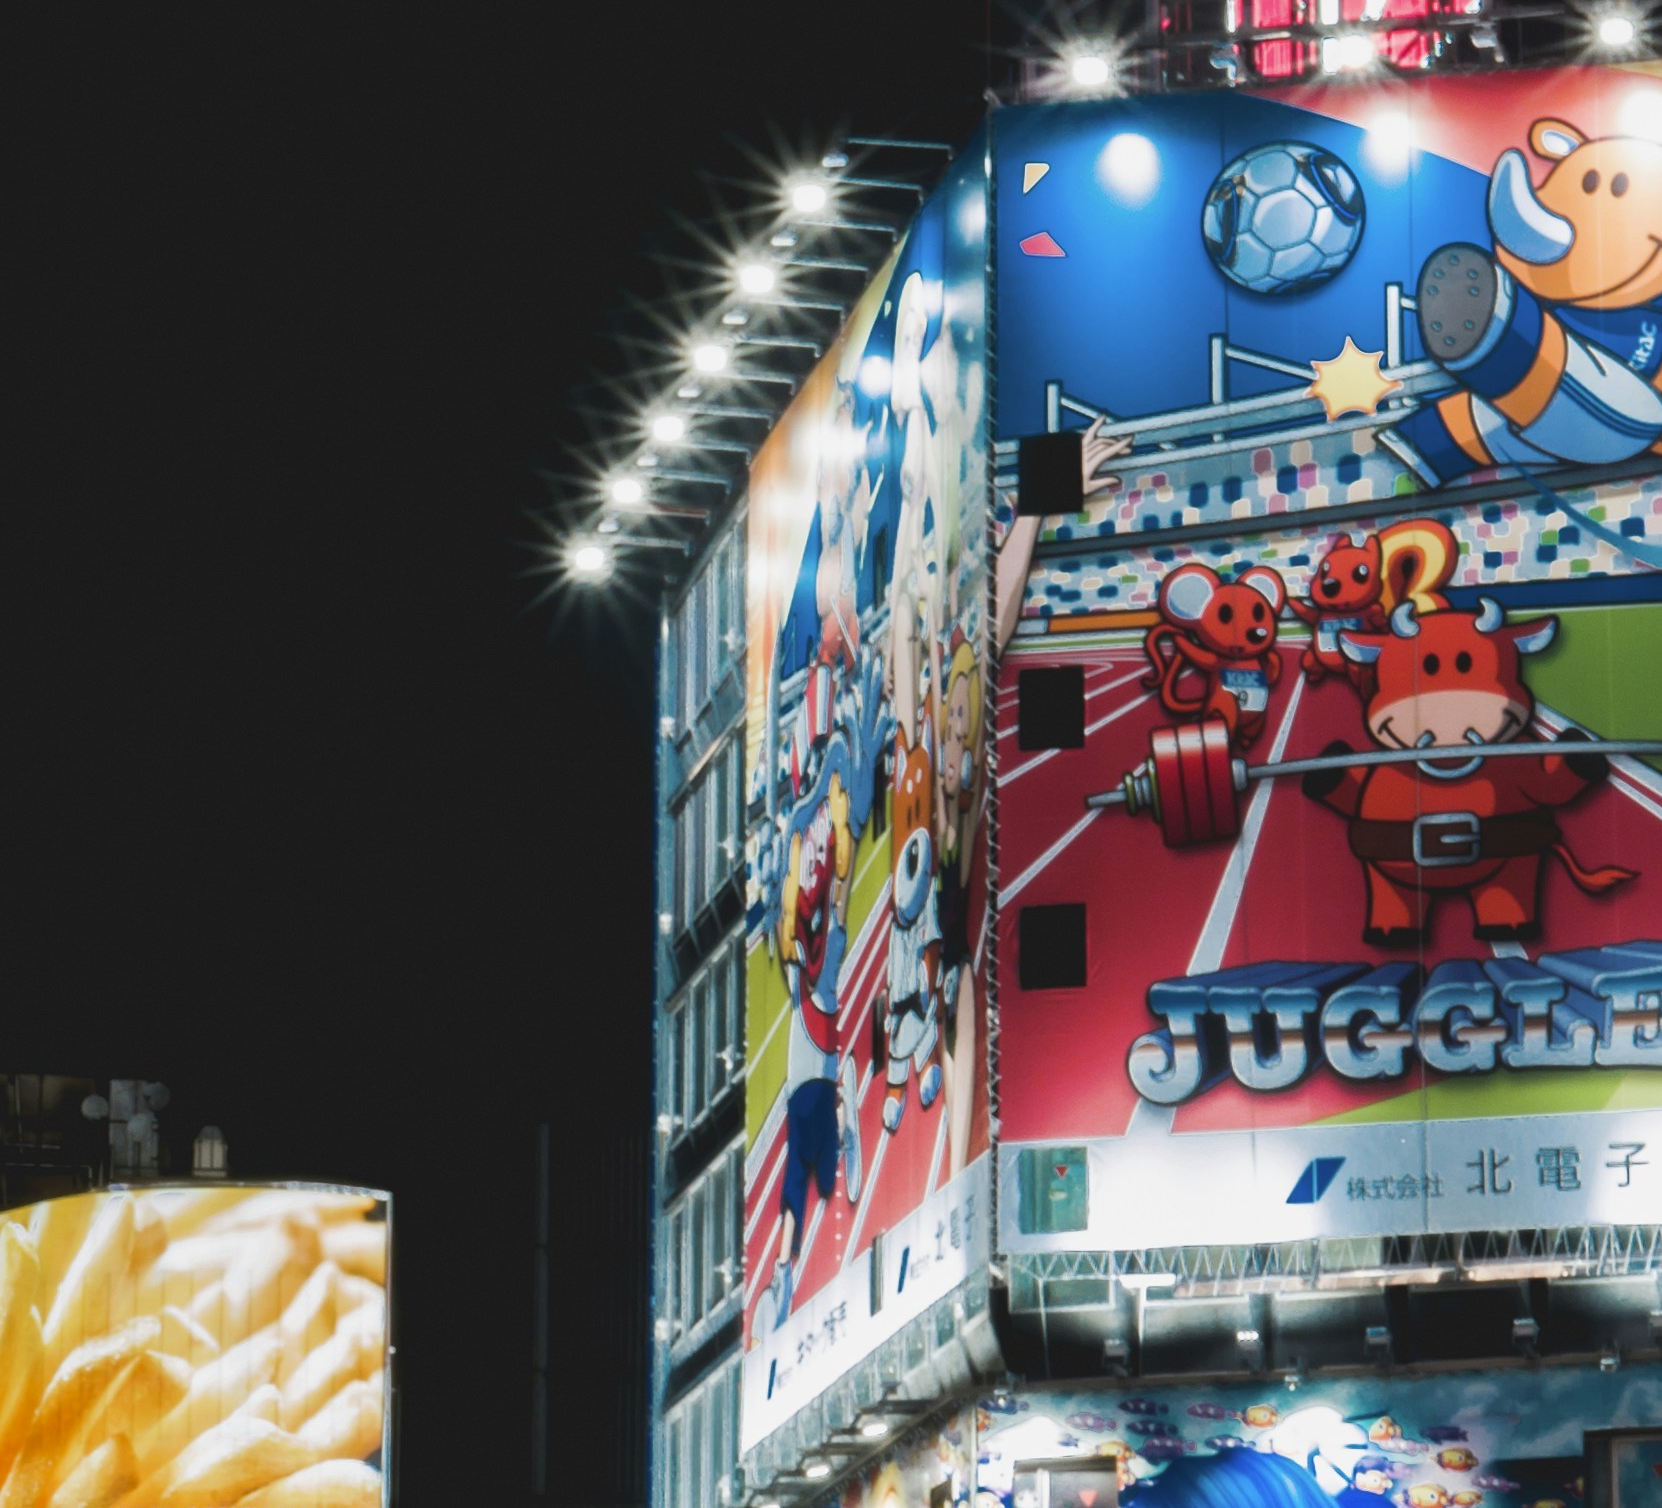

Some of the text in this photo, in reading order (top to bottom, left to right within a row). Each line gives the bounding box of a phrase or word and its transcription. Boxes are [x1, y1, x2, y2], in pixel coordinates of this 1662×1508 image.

[1346, 1142, 1650, 1201] 株式会社 北電子
